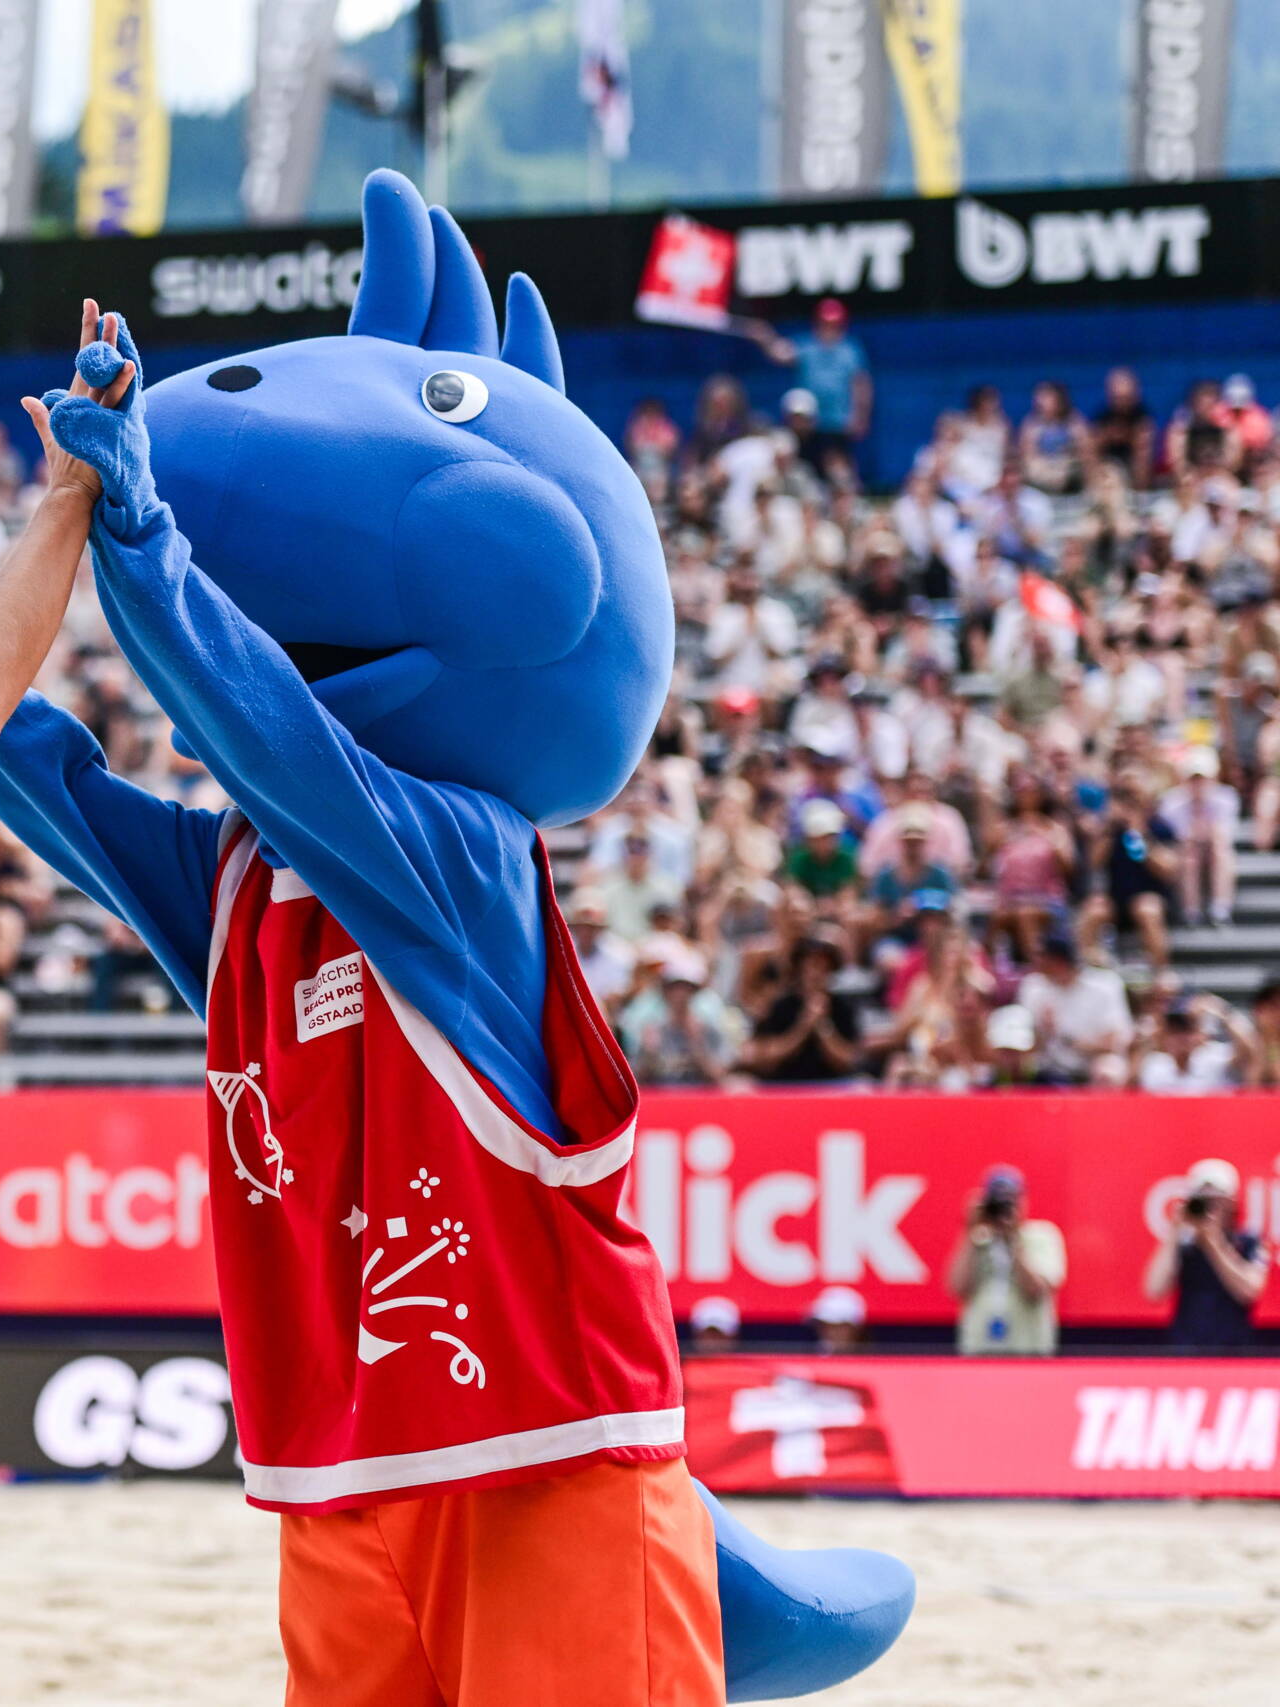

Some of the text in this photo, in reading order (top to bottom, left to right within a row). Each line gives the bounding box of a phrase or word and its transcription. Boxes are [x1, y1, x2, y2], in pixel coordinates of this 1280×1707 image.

[794, 0, 867, 190] swat
[151, 243, 363, 317] swatc
[736, 221, 911, 296] BWT
[1032, 207, 1208, 283] BWT
[304, 982, 364, 1017] BEACH PRO
[308, 1002, 363, 1029] GSTAAD
[618, 1125, 929, 1287] lick
[33, 1355, 243, 1471] GS
[1072, 1386, 1280, 1472] TANJA
